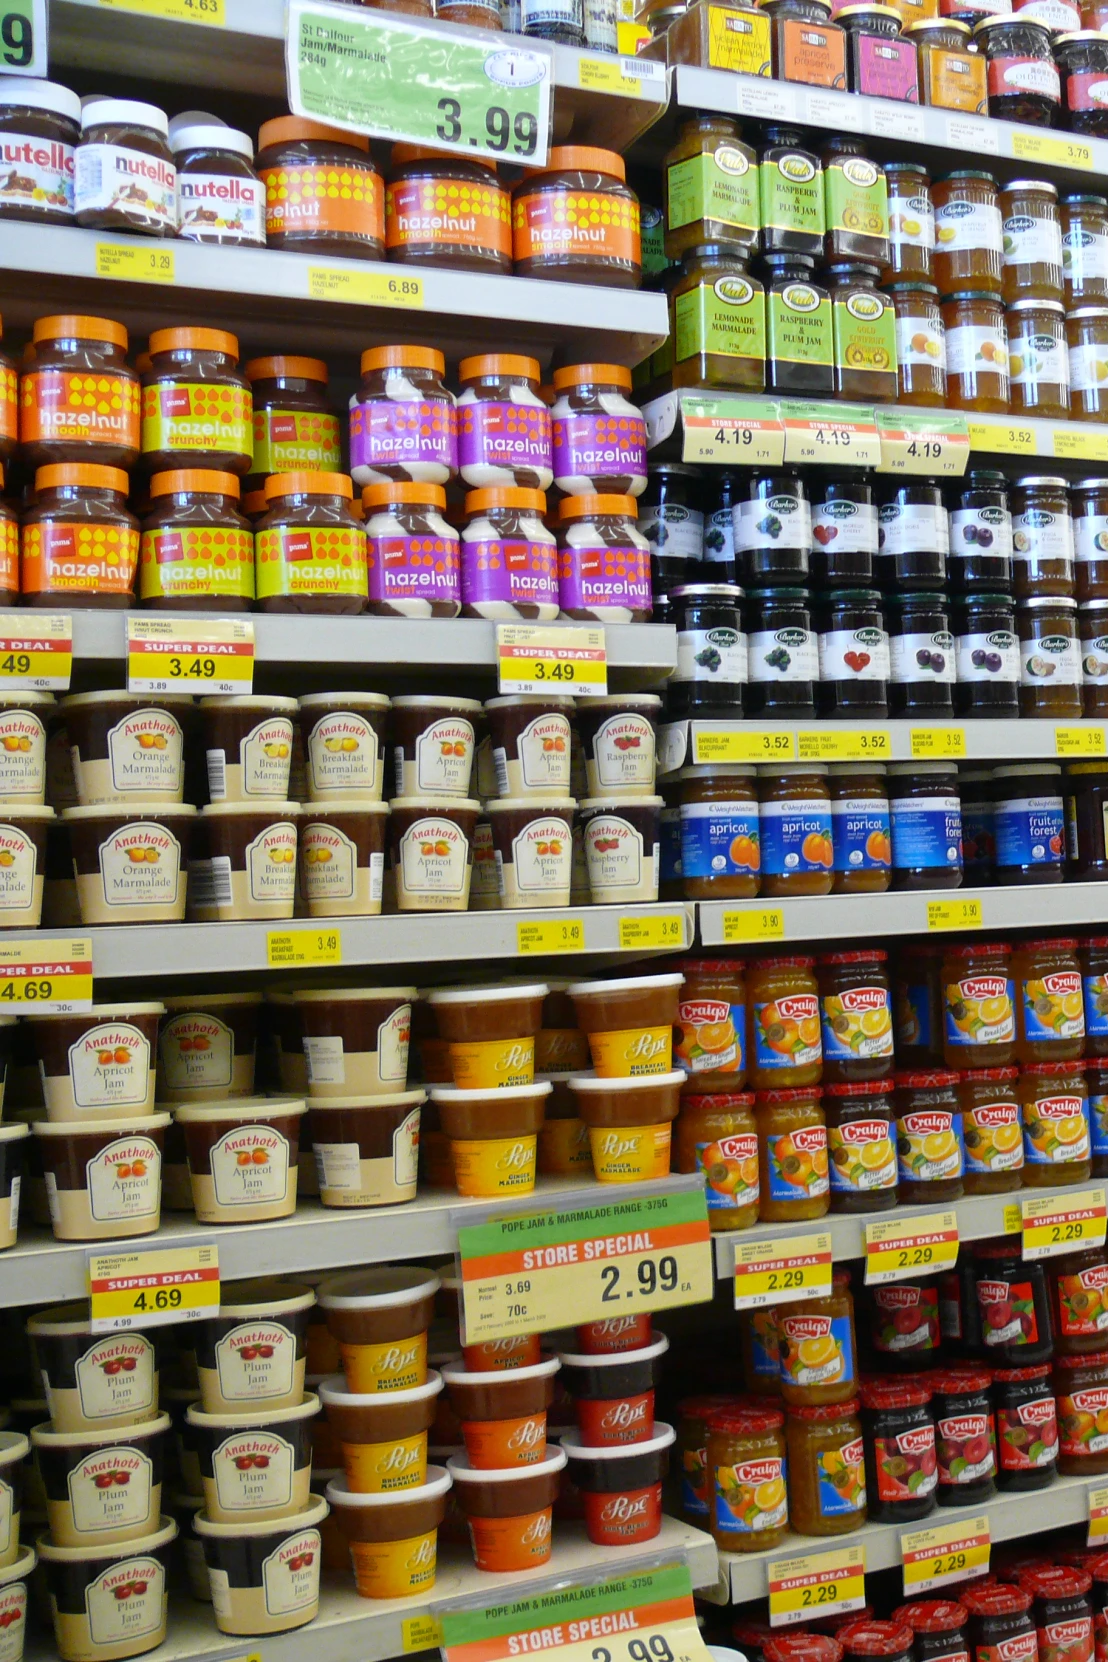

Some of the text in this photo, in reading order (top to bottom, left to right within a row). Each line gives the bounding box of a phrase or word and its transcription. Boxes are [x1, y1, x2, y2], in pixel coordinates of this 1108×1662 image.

[302, 23, 312, 35] St
[301, 36, 386, 65] Jam/Marmalade
[800, 48, 830, 60] apricot
[301, 50, 327, 68] 284g
[794, 55, 836, 70] preserve
[437, 98, 537, 157] 3.99
[1067, 146, 1090, 160] 3.79
[115, 154, 175, 187] nutella
[181, 179, 254, 201] nutella
[530, 228, 605, 242] hazelnut
[531, 239, 572, 251] smooth
[151, 254, 170, 269] 3.29
[388, 280, 419, 295] 6.89
[714, 313, 754, 325] LEMONADE
[780, 314, 823, 328] RASPBERRY
[711, 322, 757, 336] MARMALADE
[800, 327, 805, 335] &
[783, 333, 821, 346] PLUM JAM
[711, 419, 760, 429] STORE SPECIAL
[167, 435, 217, 447] crunchy
[715, 428, 752, 445] 4.19
[1009, 430, 1031, 443] 3.52
[370, 437, 447, 452] hazelnut
[908, 442, 941, 458] 4.19
[160, 563, 242, 581] hazelnut
[160, 579, 211, 592] crunchy
[582, 580, 649, 596] hazelnut
[583, 593, 610, 603] twist
[144, 642, 236, 654] SUPER DEAL
[170, 658, 215, 677] 3.49
[149, 682, 166, 690] 3.89
[125, 720, 177, 738] Anathoth
[319, 722, 367, 738] Anathoth
[606, 723, 648, 739] Anathoth
[763, 737, 789, 749] 3.52
[861, 736, 885, 748] 3.52
[132, 751, 170, 763] Orange
[322, 753, 364, 763] Breakfast
[607, 752, 648, 765] Raspberry
[123, 764, 176, 775] Marmalade
[319, 764, 368, 774] Marmalade
[620, 762, 637, 773] Jam
[1029, 816, 1050, 826] fruit
[709, 822, 749, 835] apricot
[1029, 826, 1057, 835] forest
[762, 915, 778, 927] 3.90
[318, 937, 336, 950] 3.49
[961, 979, 1004, 996] Craig's
[907, 1114, 951, 1133] Craig's
[225, 1134, 278, 1153] Anathoth
[233, 1165, 272, 1177] Apricot
[243, 1177, 263, 1189] Jam
[502, 1220, 525, 1234] POPE
[528, 1218, 545, 1230] JAM
[548, 1216, 554, 1227] &
[557, 1206, 612, 1225] MARMALADE
[614, 1203, 642, 1217] RANGE
[523, 1232, 654, 1269] STORE SPECIAL
[97, 1264, 120, 1272] APRICOT
[747, 1257, 819, 1272] SUPER DEAL
[108, 1272, 203, 1290] SUPER DEAL
[601, 1255, 679, 1303] 2.99
[768, 1270, 803, 1291] 2.29
[506, 1280, 531, 1295] 3.69
[682, 1283, 691, 1292] EA
[134, 1288, 182, 1311] 4.69
[752, 1296, 766, 1304] 2.79
[508, 1304, 527, 1317] 70c
[114, 1310, 201, 1328] 4.99 30c
[224, 1441, 280, 1458] Anathoth
[239, 1471, 267, 1483] Plum
[244, 1483, 264, 1495] Jam
[781, 1570, 851, 1590] SUPER DEAL
[485, 1606, 509, 1620] POPE
[511, 1603, 529, 1616] JAM
[532, 1601, 538, 1611] &
[541, 1590, 597, 1609] MARMALADE
[598, 1585, 627, 1601] RANGE
[802, 1585, 838, 1606] 2.29
[509, 1611, 638, 1654] STORE SPECIAL
